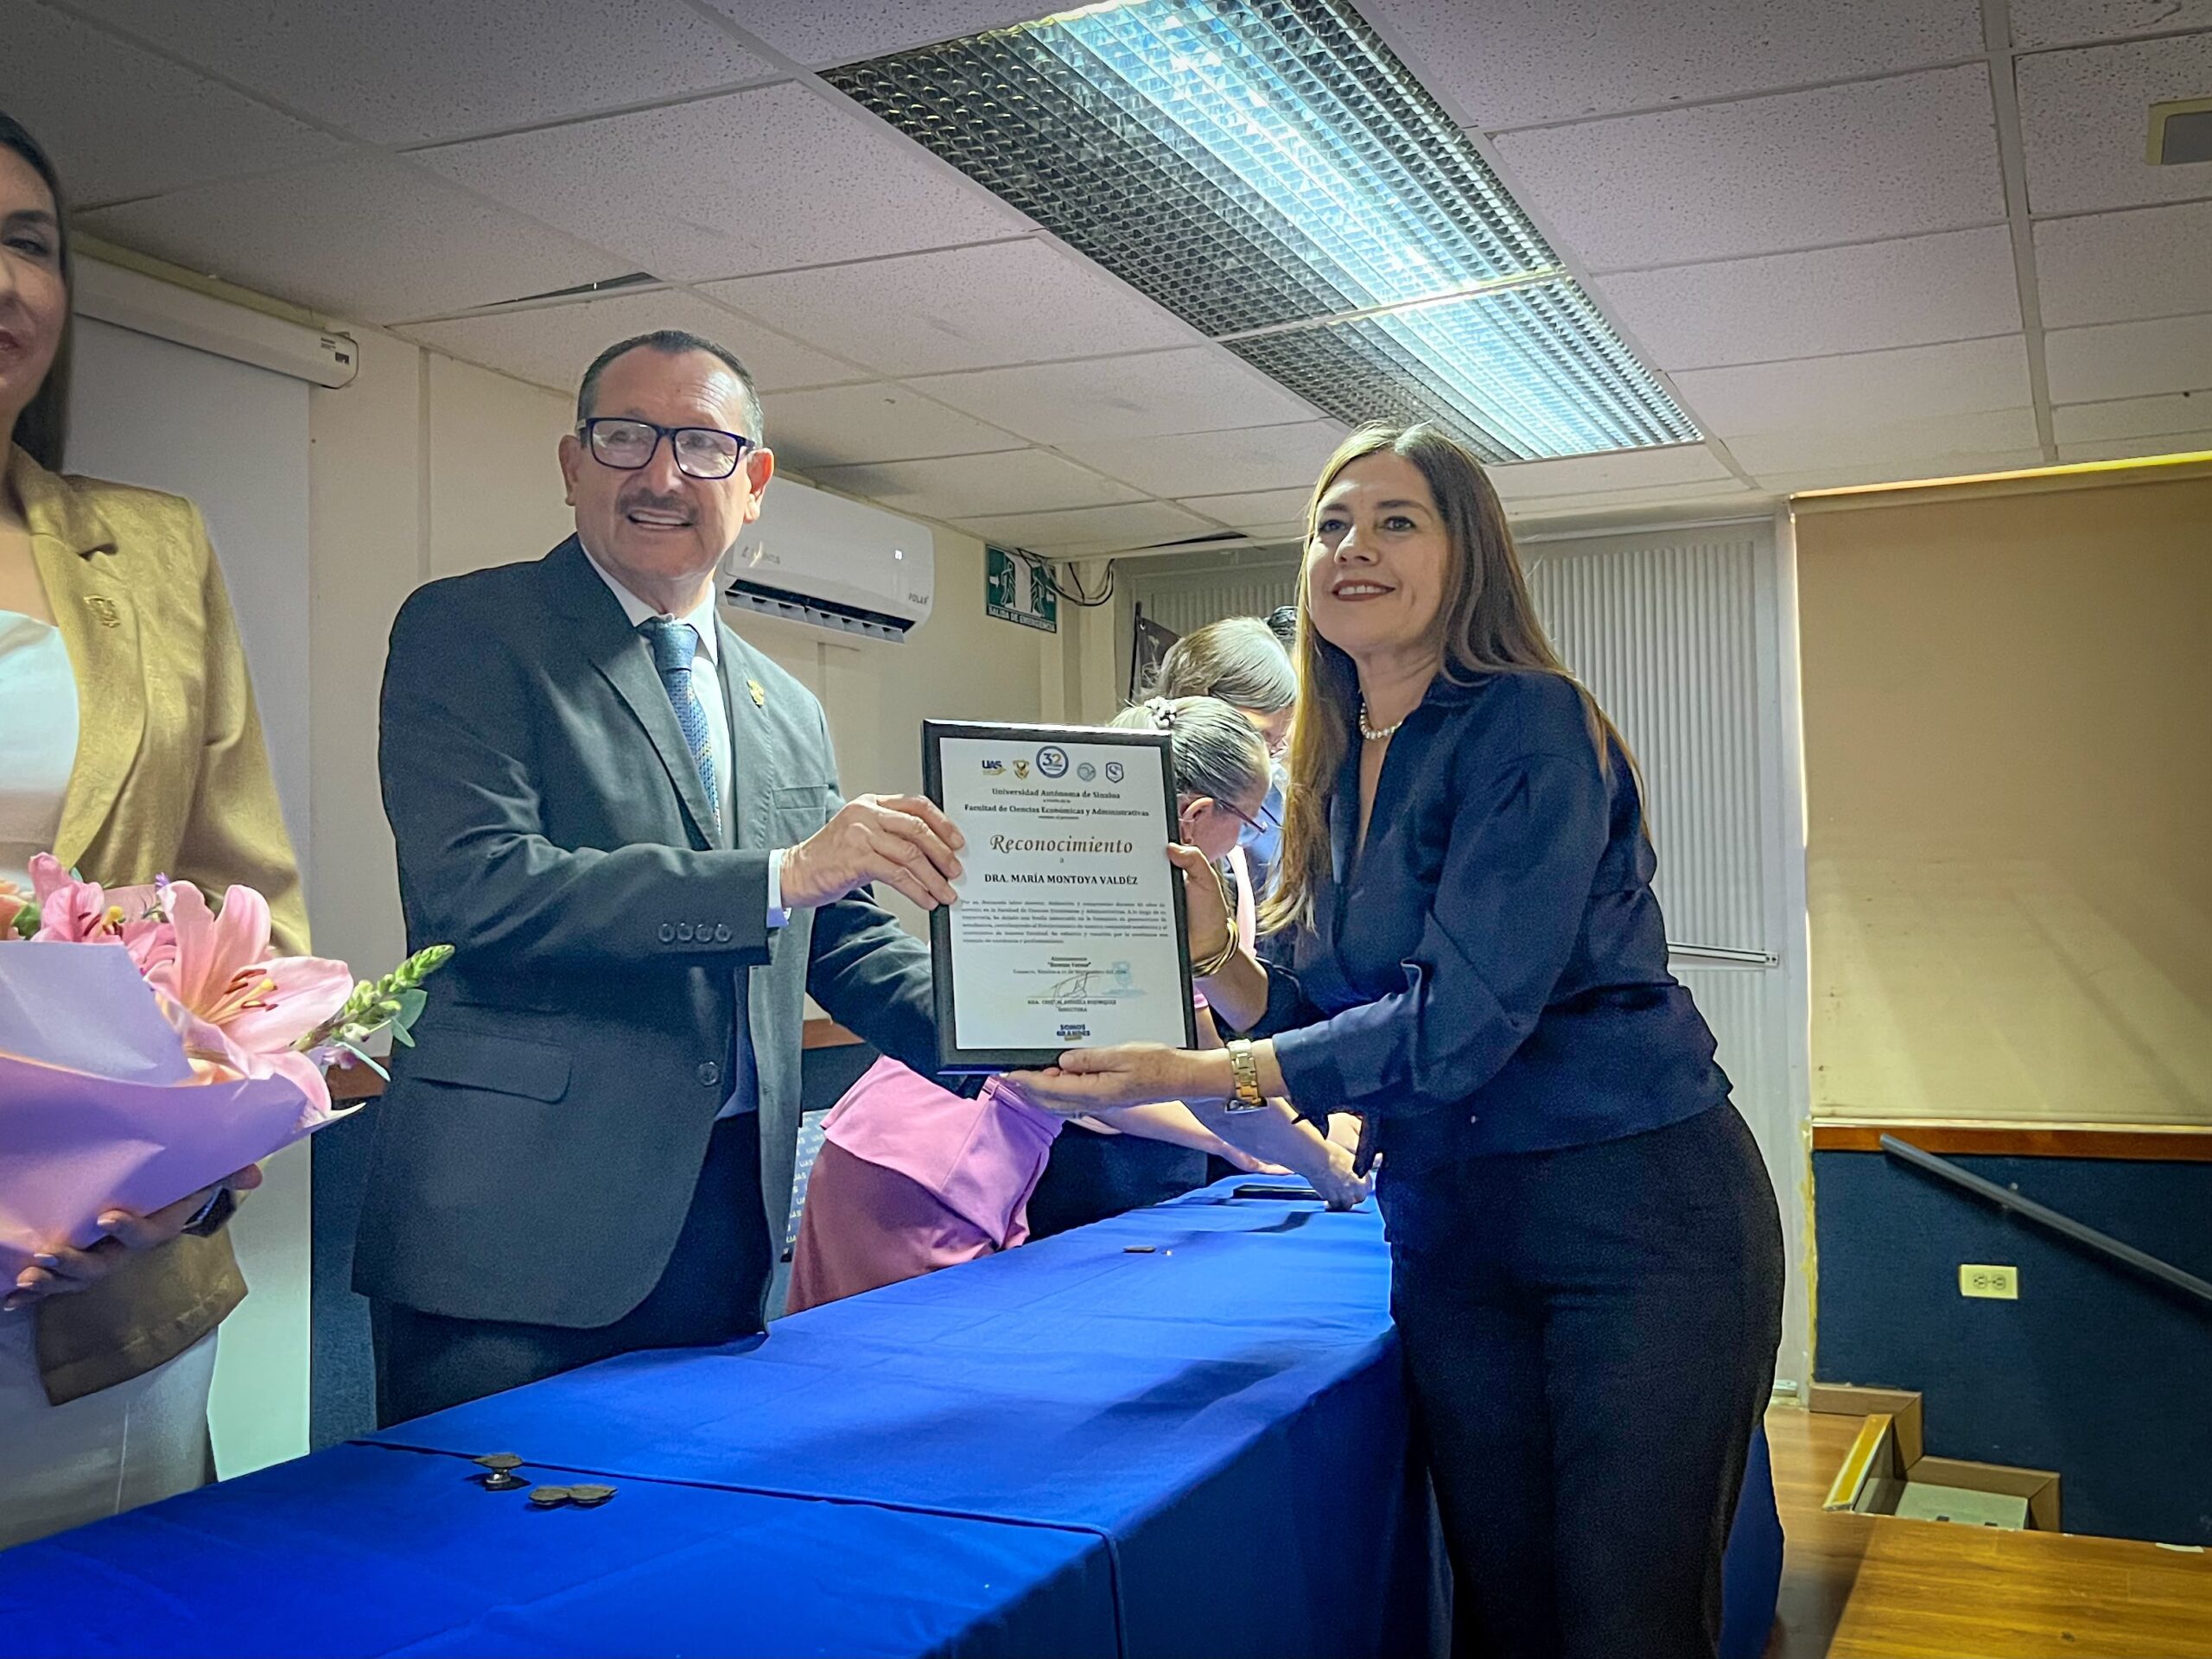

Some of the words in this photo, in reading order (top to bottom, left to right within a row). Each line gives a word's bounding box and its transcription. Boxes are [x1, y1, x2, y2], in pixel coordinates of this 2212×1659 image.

[982, 760, 1002, 769] UAS
[1042, 753, 1063, 766] 32
[1040, 788, 1080, 798] Autónoma
[1092, 791, 1121, 799] Sinaloa
[964, 804, 996, 812] Facultad
[1009, 804, 1039, 813] Ciencias
[1041, 806, 1084, 815] Económicas
[1091, 808, 1150, 817] Administrativas
[989, 834, 1134, 854] Reconocimiento
[984, 874, 1008, 883] DRA.
[1011, 873, 1045, 884] MARÍA
[1047, 874, 1097, 885] MONTOYA
[1100, 874, 1139, 886] VALDÉZ
